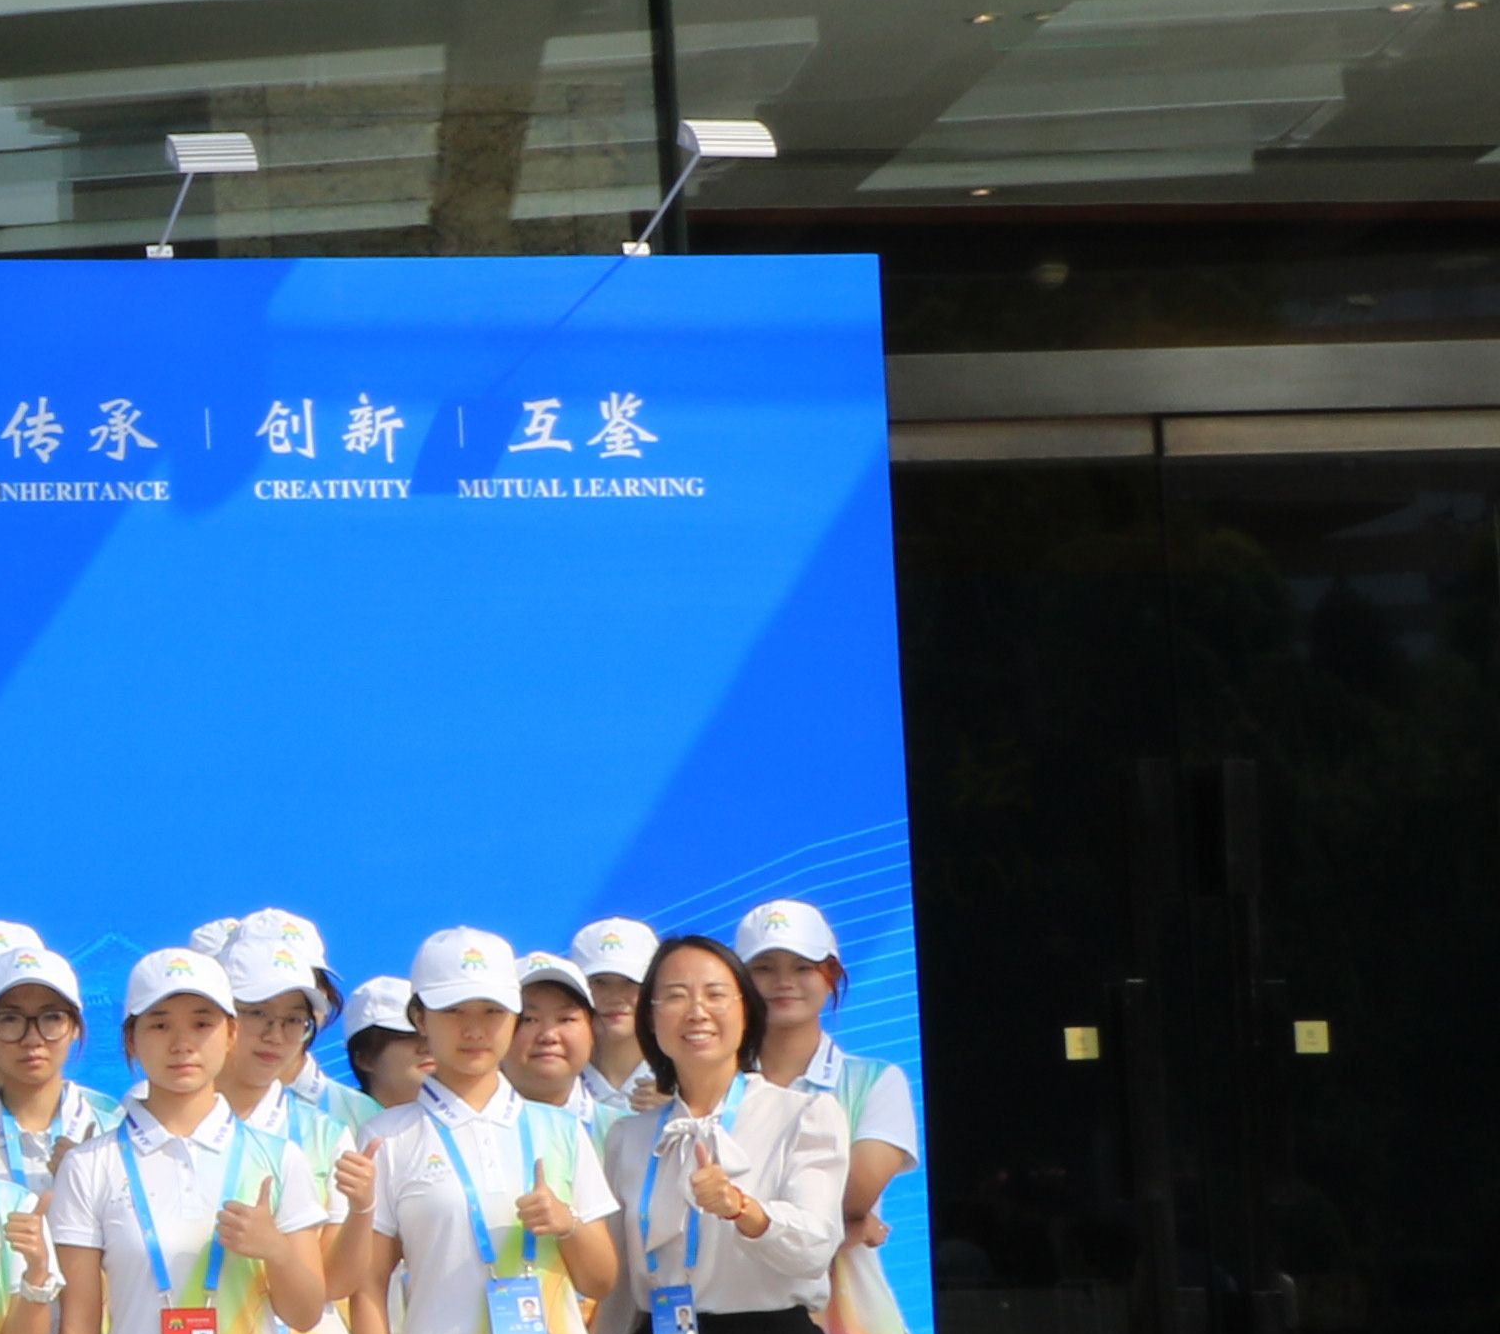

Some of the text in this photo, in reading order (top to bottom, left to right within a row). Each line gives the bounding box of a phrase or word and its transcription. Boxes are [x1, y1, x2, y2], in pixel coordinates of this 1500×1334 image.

[0, 392, 660, 464] 传承 创新 互鉴
[254, 478, 411, 500] CREATIVITY
[458, 478, 568, 499] MUTUAL
[572, 477, 706, 498] LEARNING
